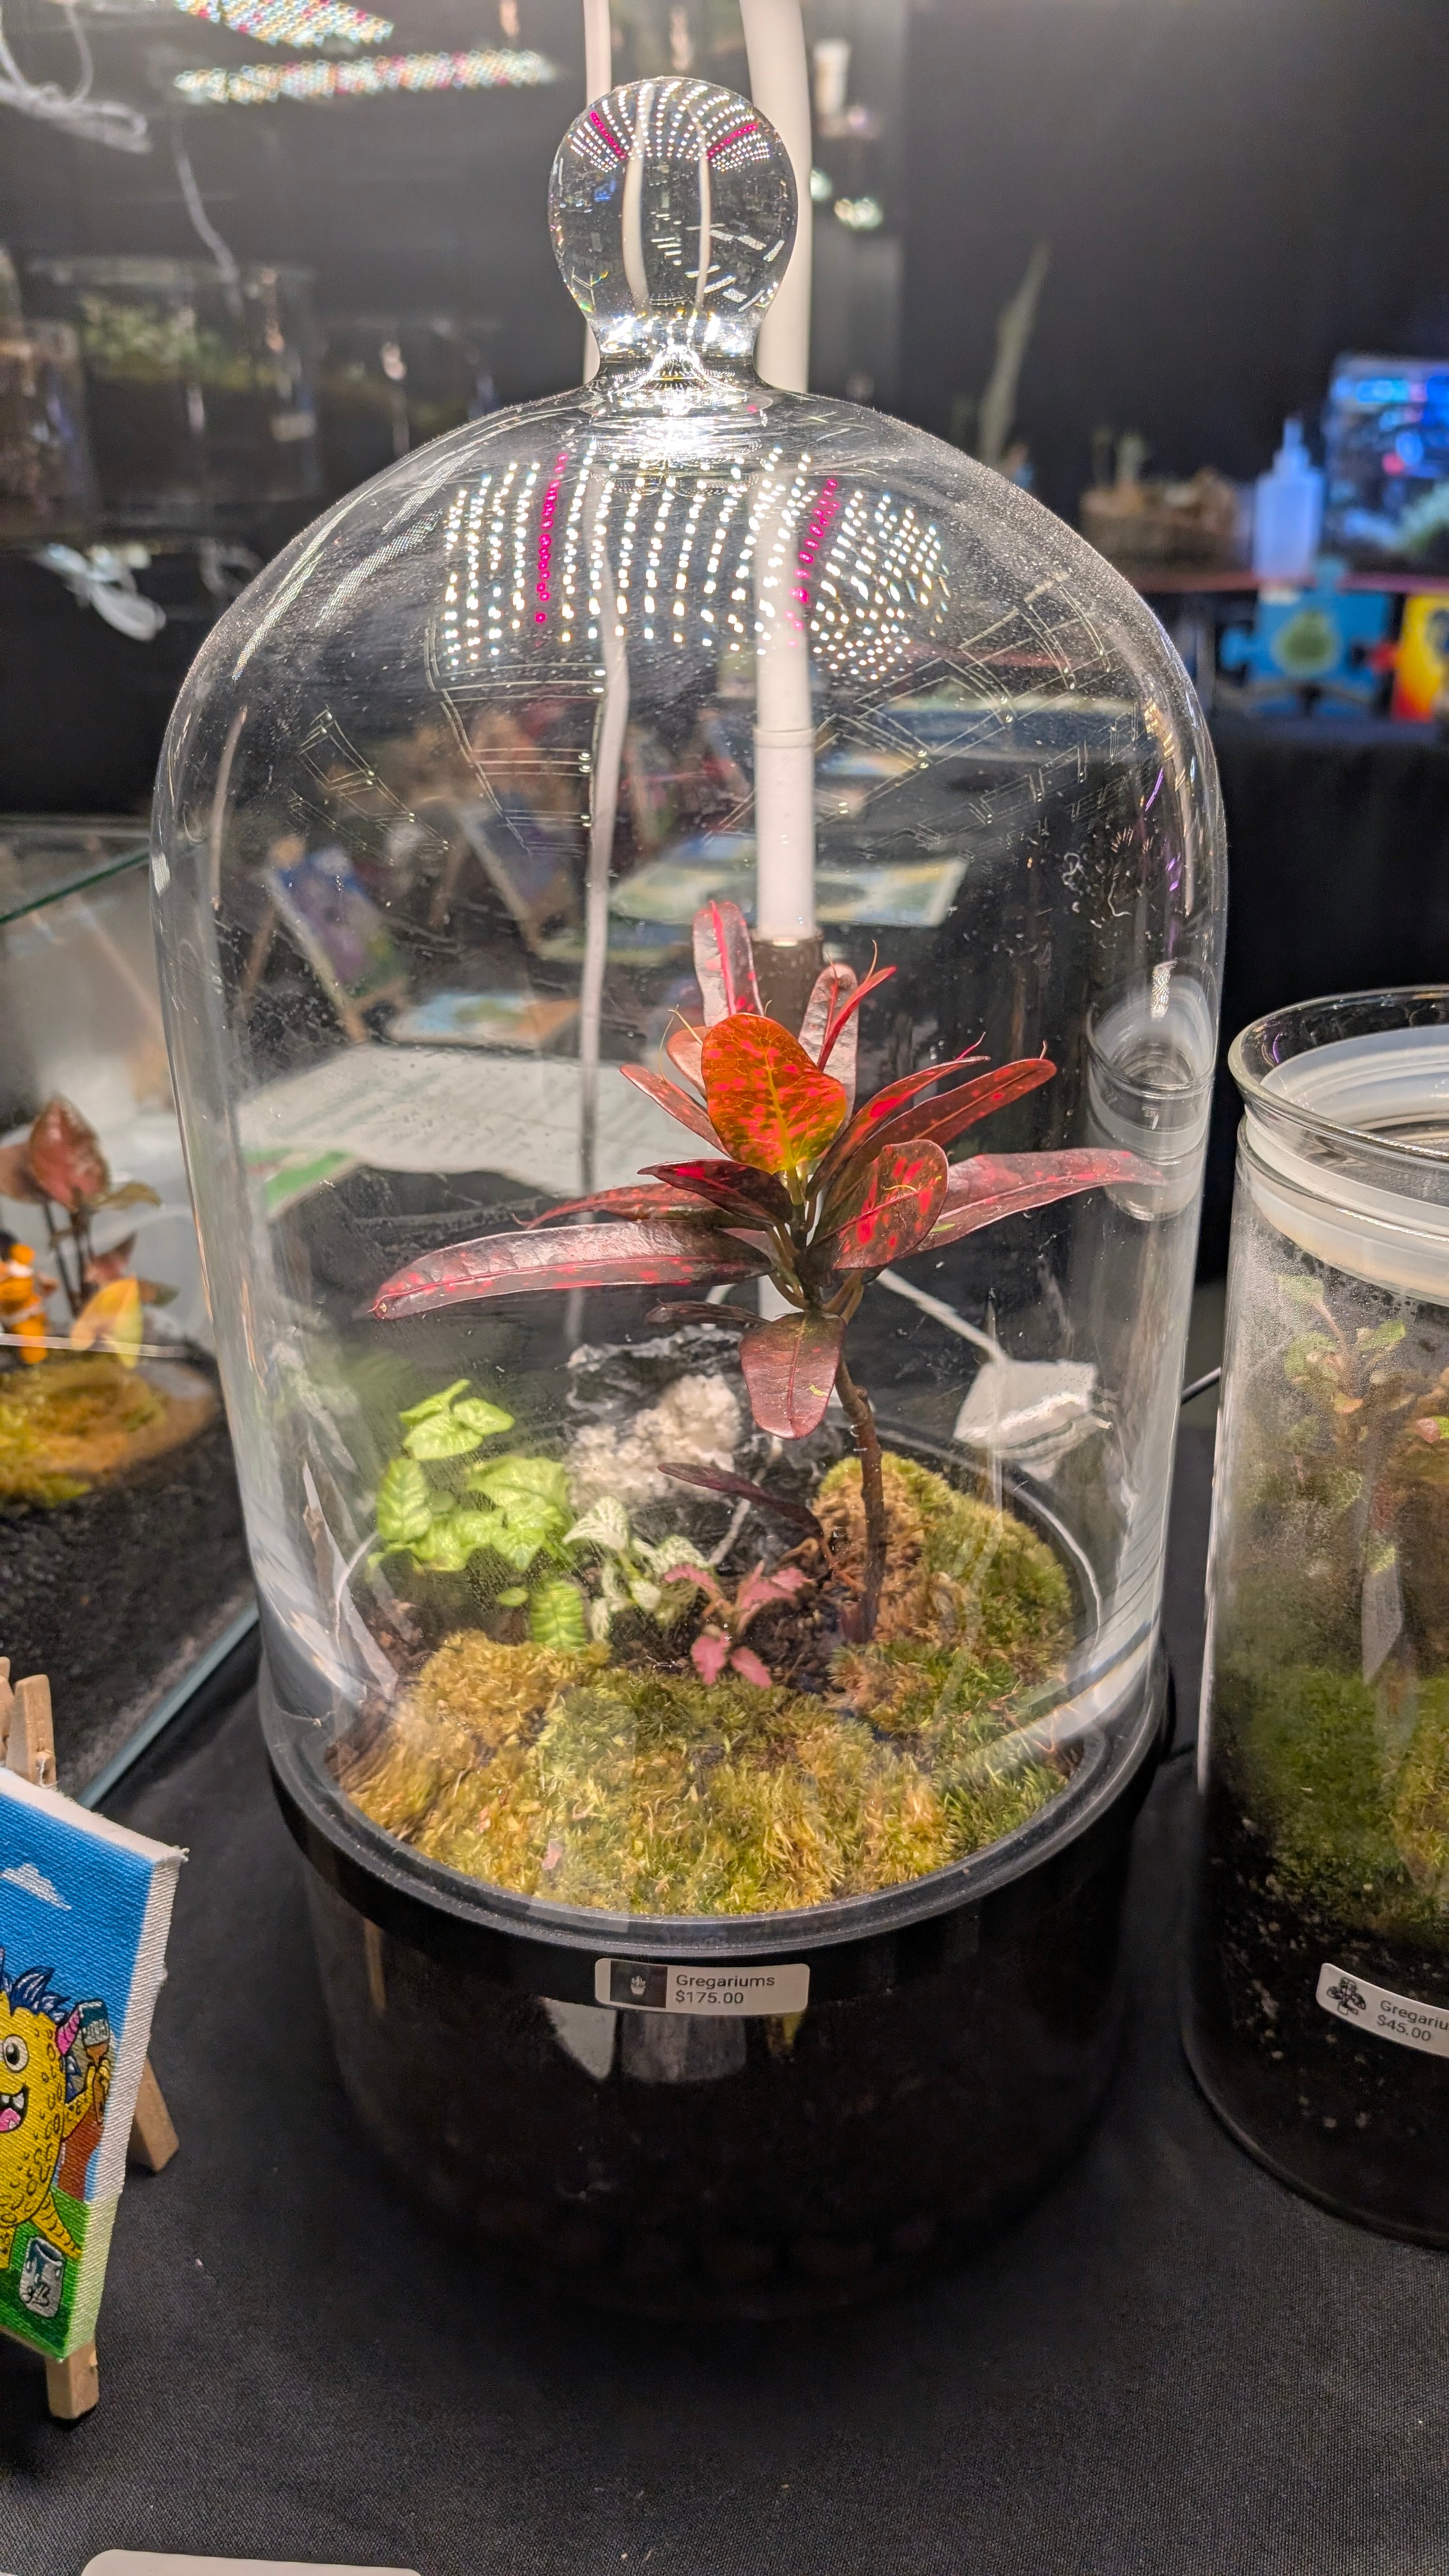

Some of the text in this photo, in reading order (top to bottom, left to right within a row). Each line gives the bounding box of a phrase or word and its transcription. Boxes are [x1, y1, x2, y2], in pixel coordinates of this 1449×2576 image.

[676, 1974, 775, 1989] Gregariums
[675, 1989, 744, 2004] $175.00
[1380, 2000, 1449, 2030] Gregariu
[1377, 2014, 1431, 2041] $45.00
